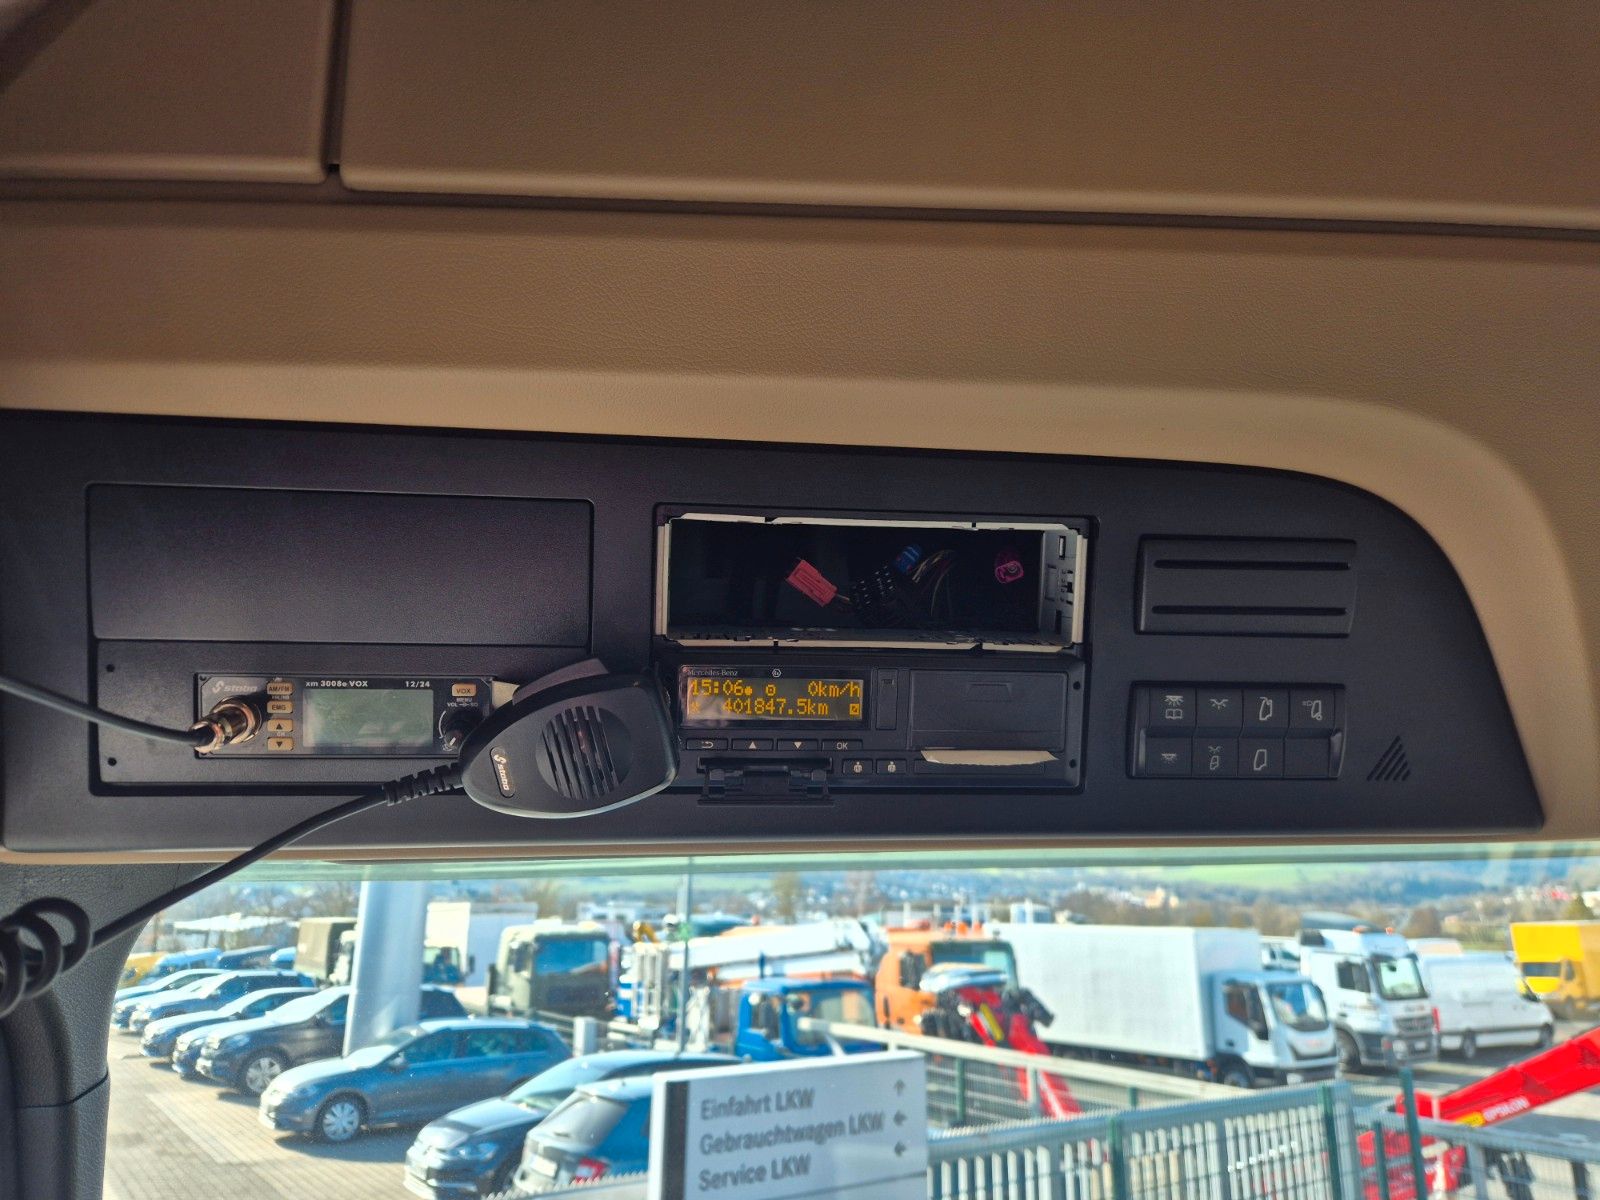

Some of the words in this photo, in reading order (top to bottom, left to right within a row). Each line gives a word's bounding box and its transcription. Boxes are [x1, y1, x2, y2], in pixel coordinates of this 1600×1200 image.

[687, 669, 738, 677] Mercedes-Benz
[349, 680, 368, 688] VOX
[405, 680, 431, 688] 12/24
[690, 679, 743, 696] 15:06
[808, 681, 861, 698] 0km/h
[722, 698, 829, 715] 401847.5km
[836, 741, 848, 750] OK
[701, 1094, 771, 1120] Einfahrt
[775, 1087, 816, 1111] LKW
[700, 1119, 846, 1155] Gebrauchtwagen
[848, 1110, 886, 1136] LKW
[699, 1164, 767, 1191] Service
[771, 1154, 813, 1180] LKW
